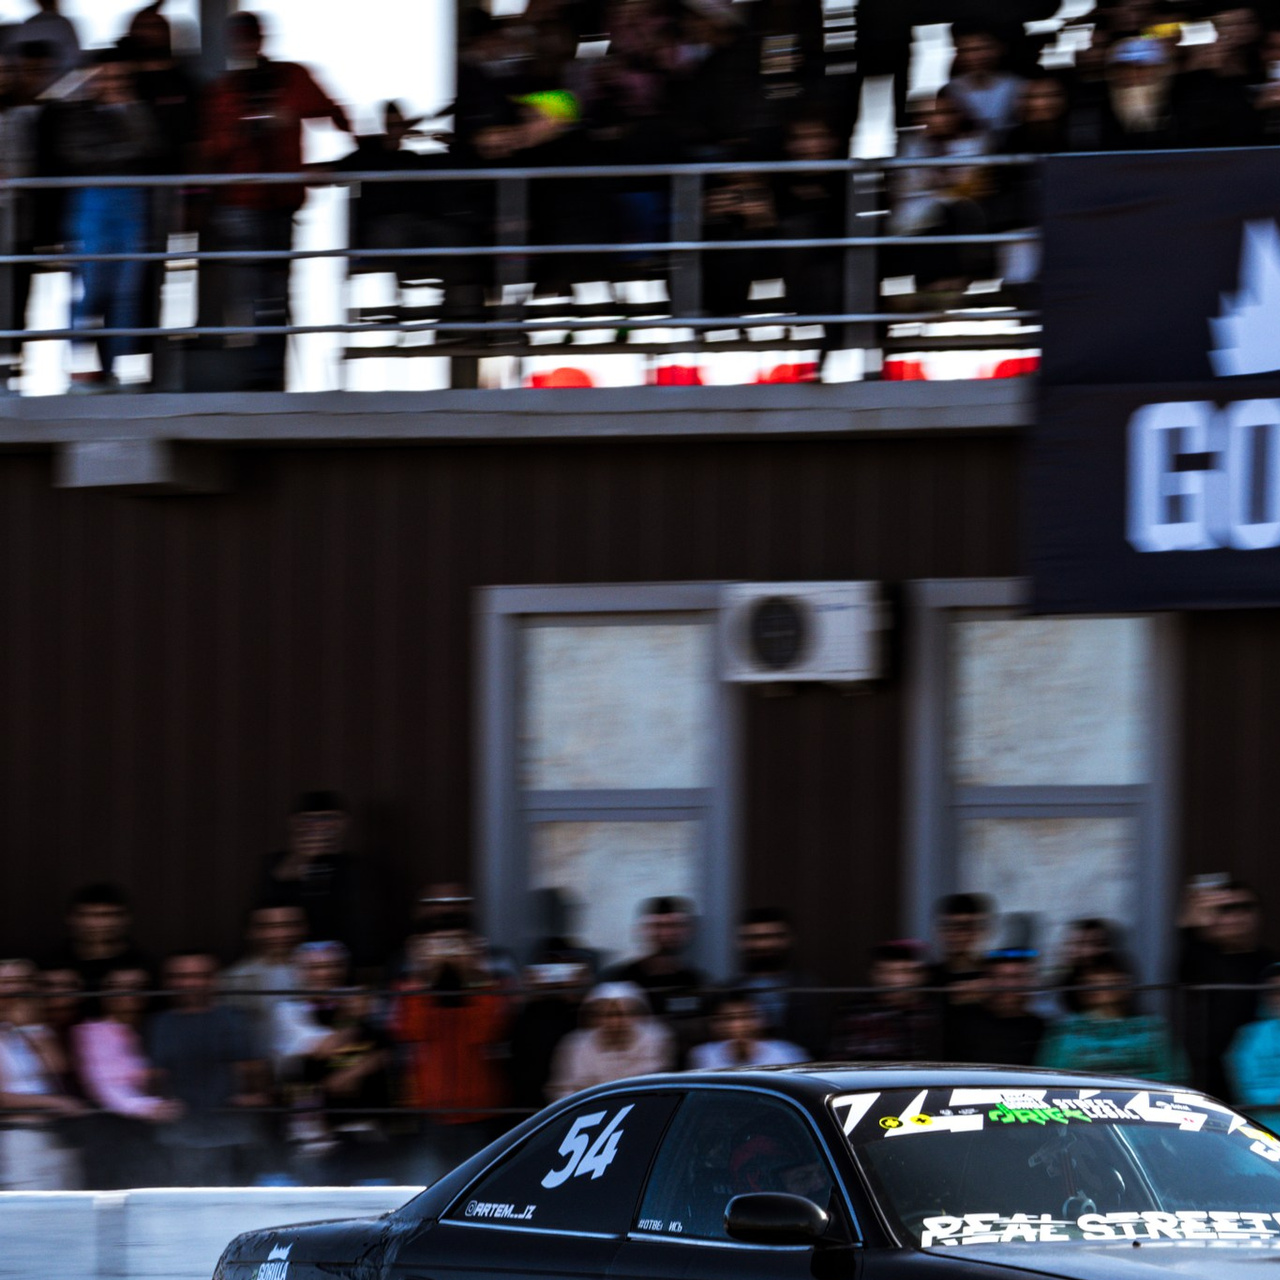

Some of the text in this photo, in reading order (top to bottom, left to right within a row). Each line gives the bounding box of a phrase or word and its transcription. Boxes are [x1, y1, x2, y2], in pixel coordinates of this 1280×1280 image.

[541, 1103, 636, 1188] 54
[921, 1211, 1280, 1248] REAL STREET
